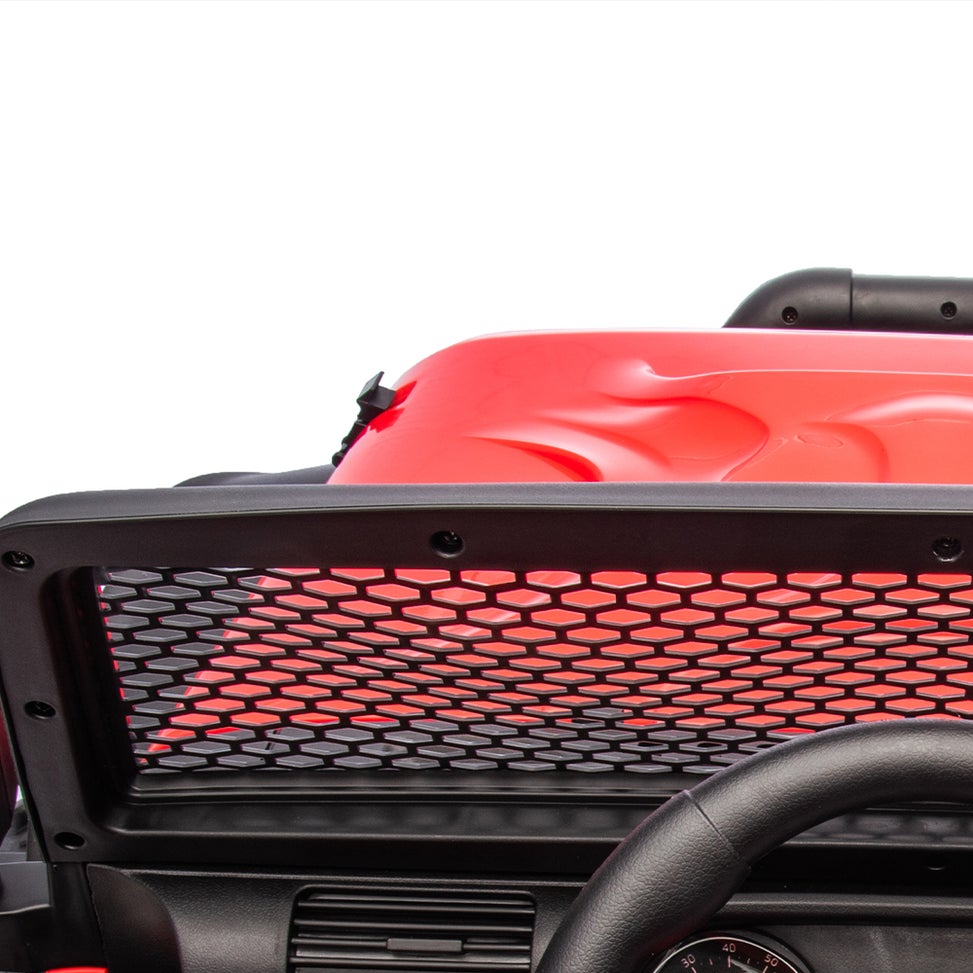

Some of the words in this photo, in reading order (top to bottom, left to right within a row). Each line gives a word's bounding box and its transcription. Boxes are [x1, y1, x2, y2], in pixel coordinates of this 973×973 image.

[722, 943, 736, 952] 40
[681, 953, 696, 968] 30
[764, 954, 779, 967] 50
